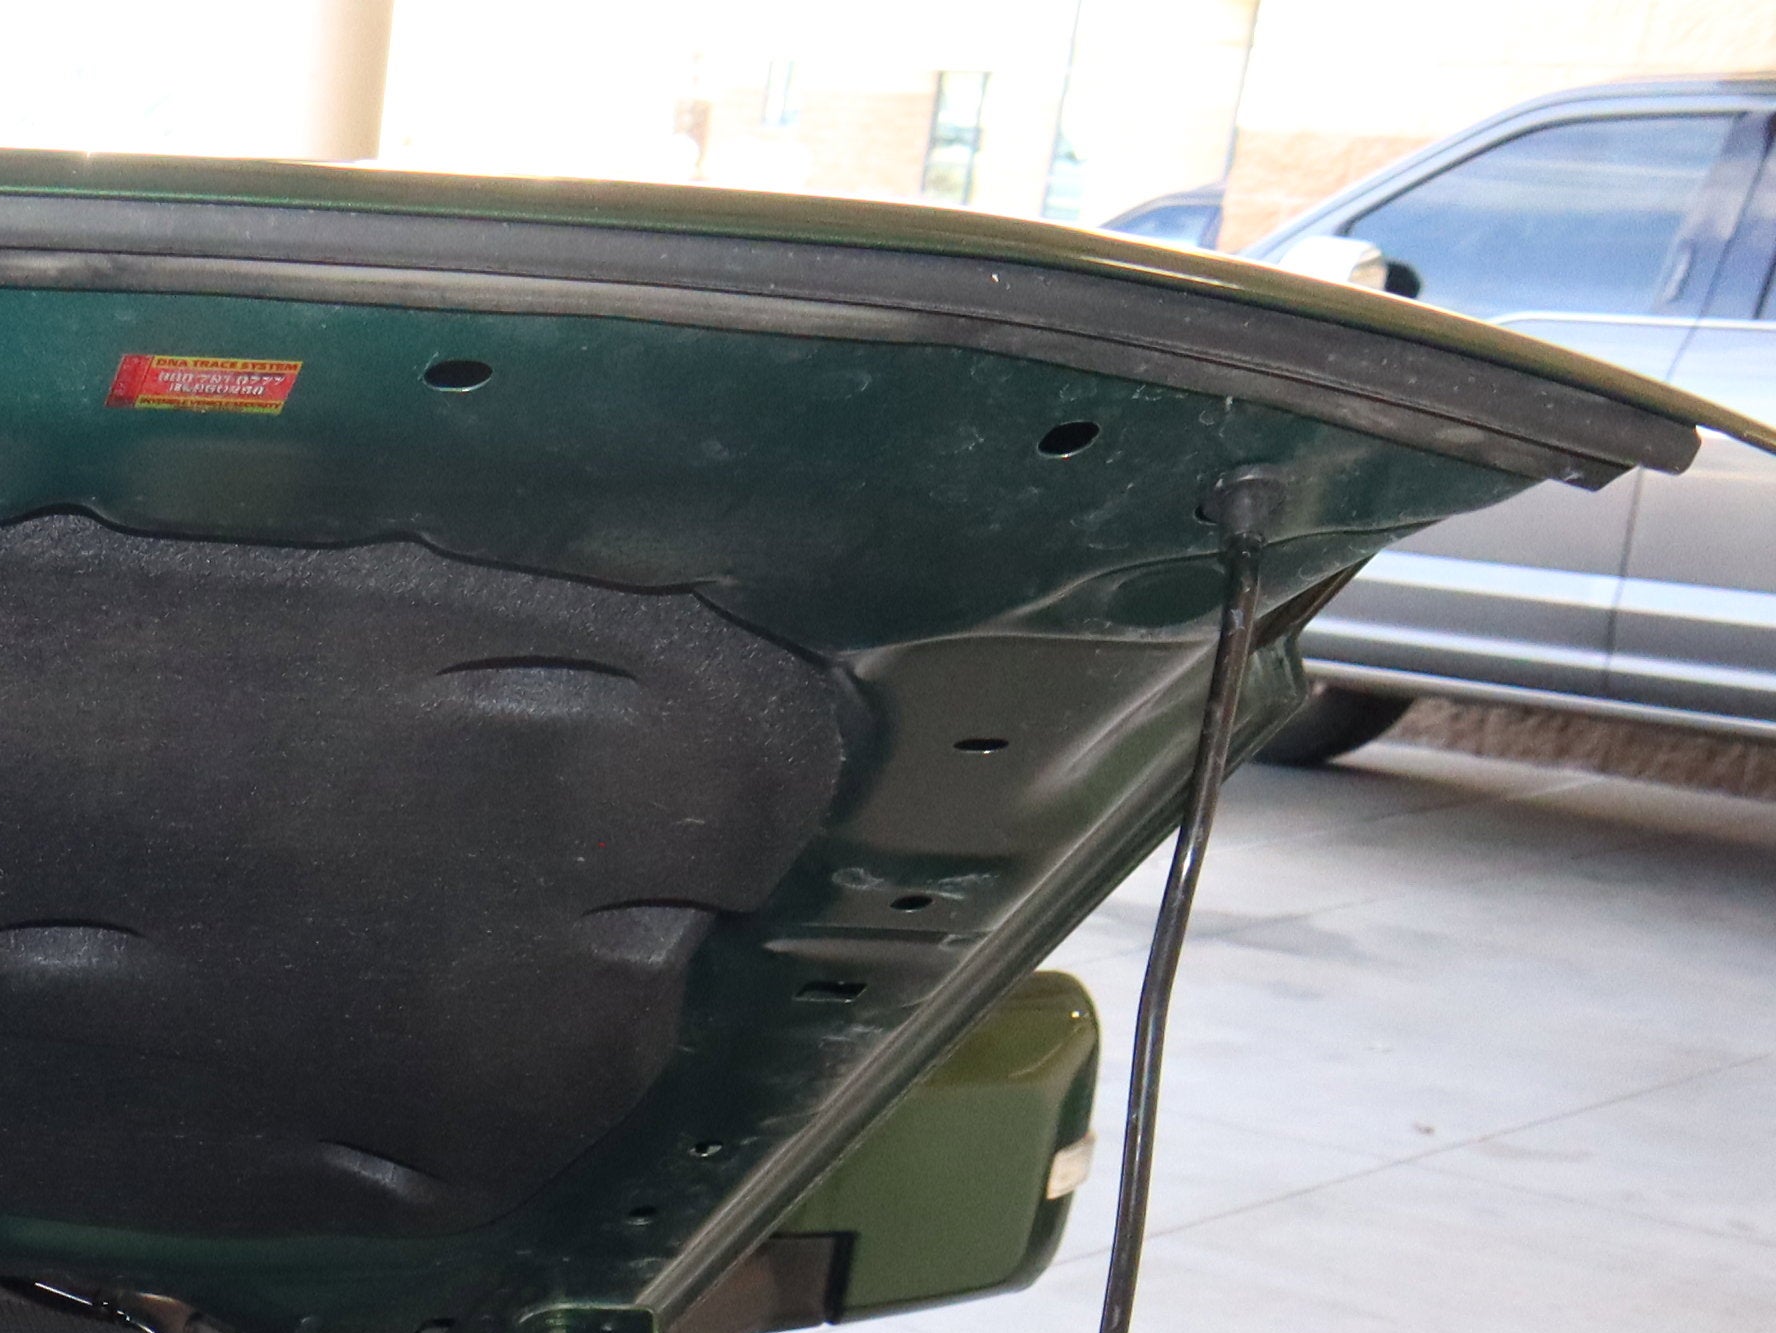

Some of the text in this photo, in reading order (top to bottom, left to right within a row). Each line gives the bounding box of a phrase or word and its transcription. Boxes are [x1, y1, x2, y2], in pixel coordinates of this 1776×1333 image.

[156, 359, 298, 371] DNA TRACE SYSTEM
